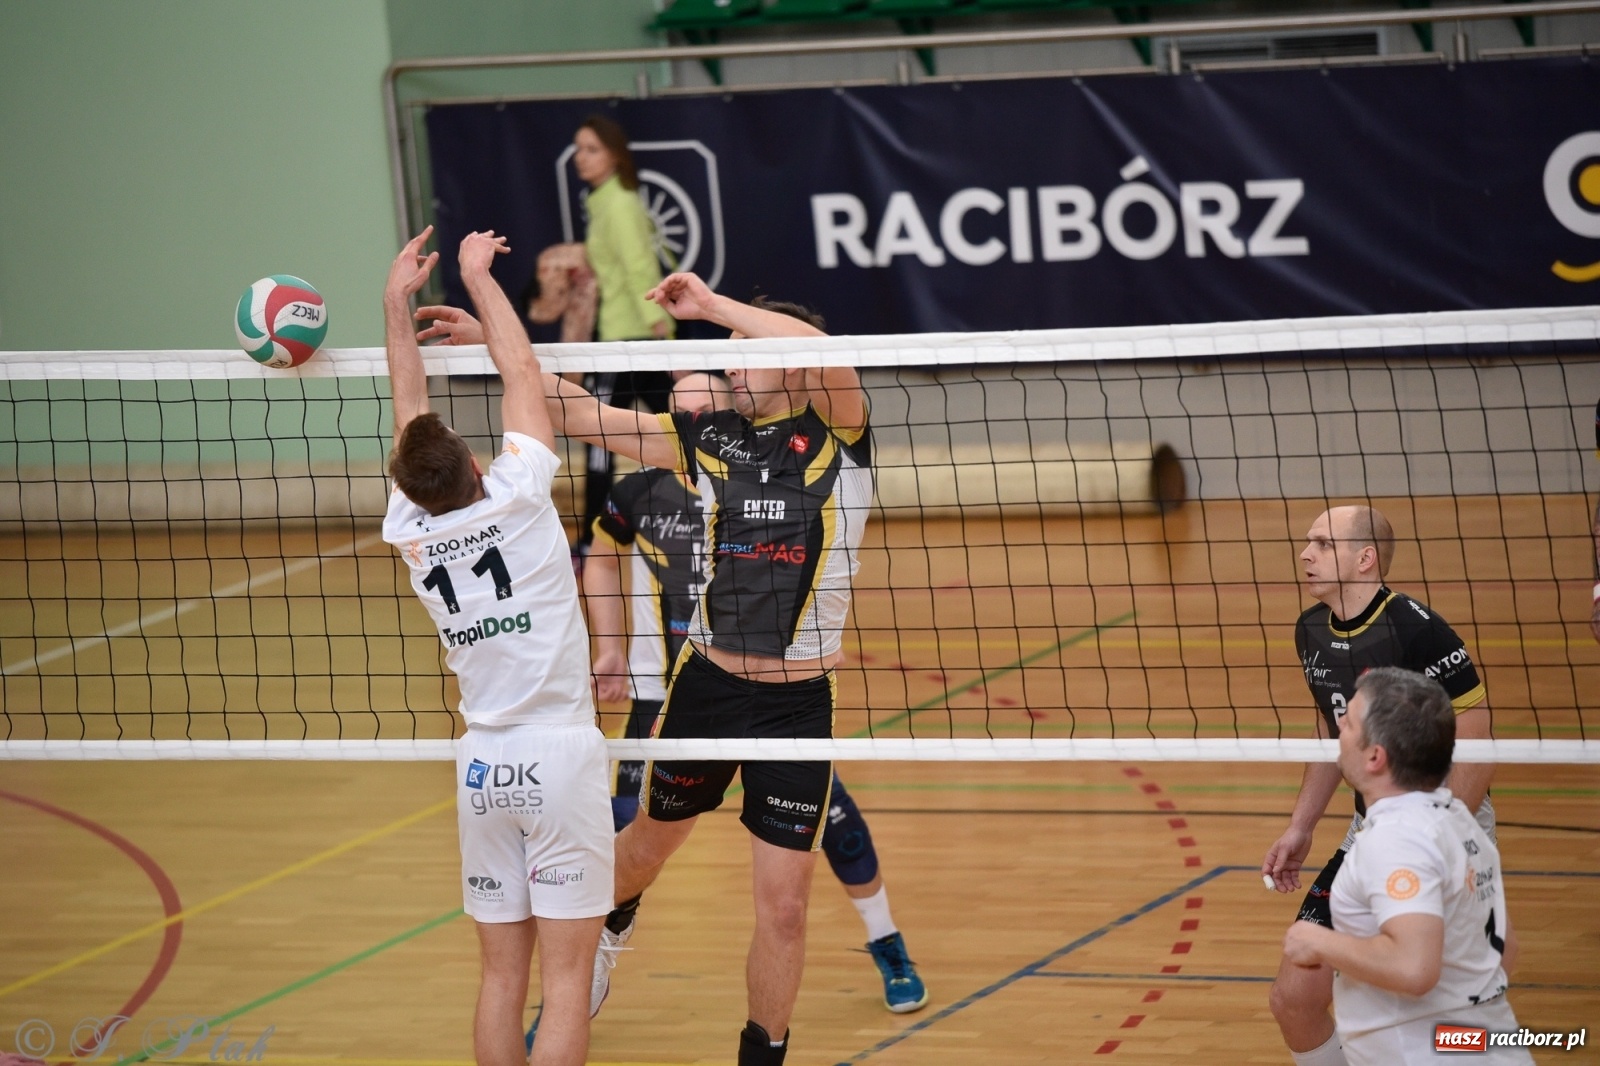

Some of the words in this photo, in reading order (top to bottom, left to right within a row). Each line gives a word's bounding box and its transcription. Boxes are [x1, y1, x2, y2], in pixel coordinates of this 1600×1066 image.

[811, 154, 1310, 269] RACIBÓRZ
[292, 304, 320, 322] MECZ
[743, 500, 786, 519] ENTER
[425, 524, 502, 557] ZOO-MAR
[422, 545, 513, 615] 11
[442, 611, 532, 648] TropiDog
[493, 761, 541, 787] DK
[470, 785, 543, 815] glass
[766, 796, 818, 813] GRAVTON
[762, 815, 793, 831] GTrans
[538, 868, 585, 886] kolgraf
